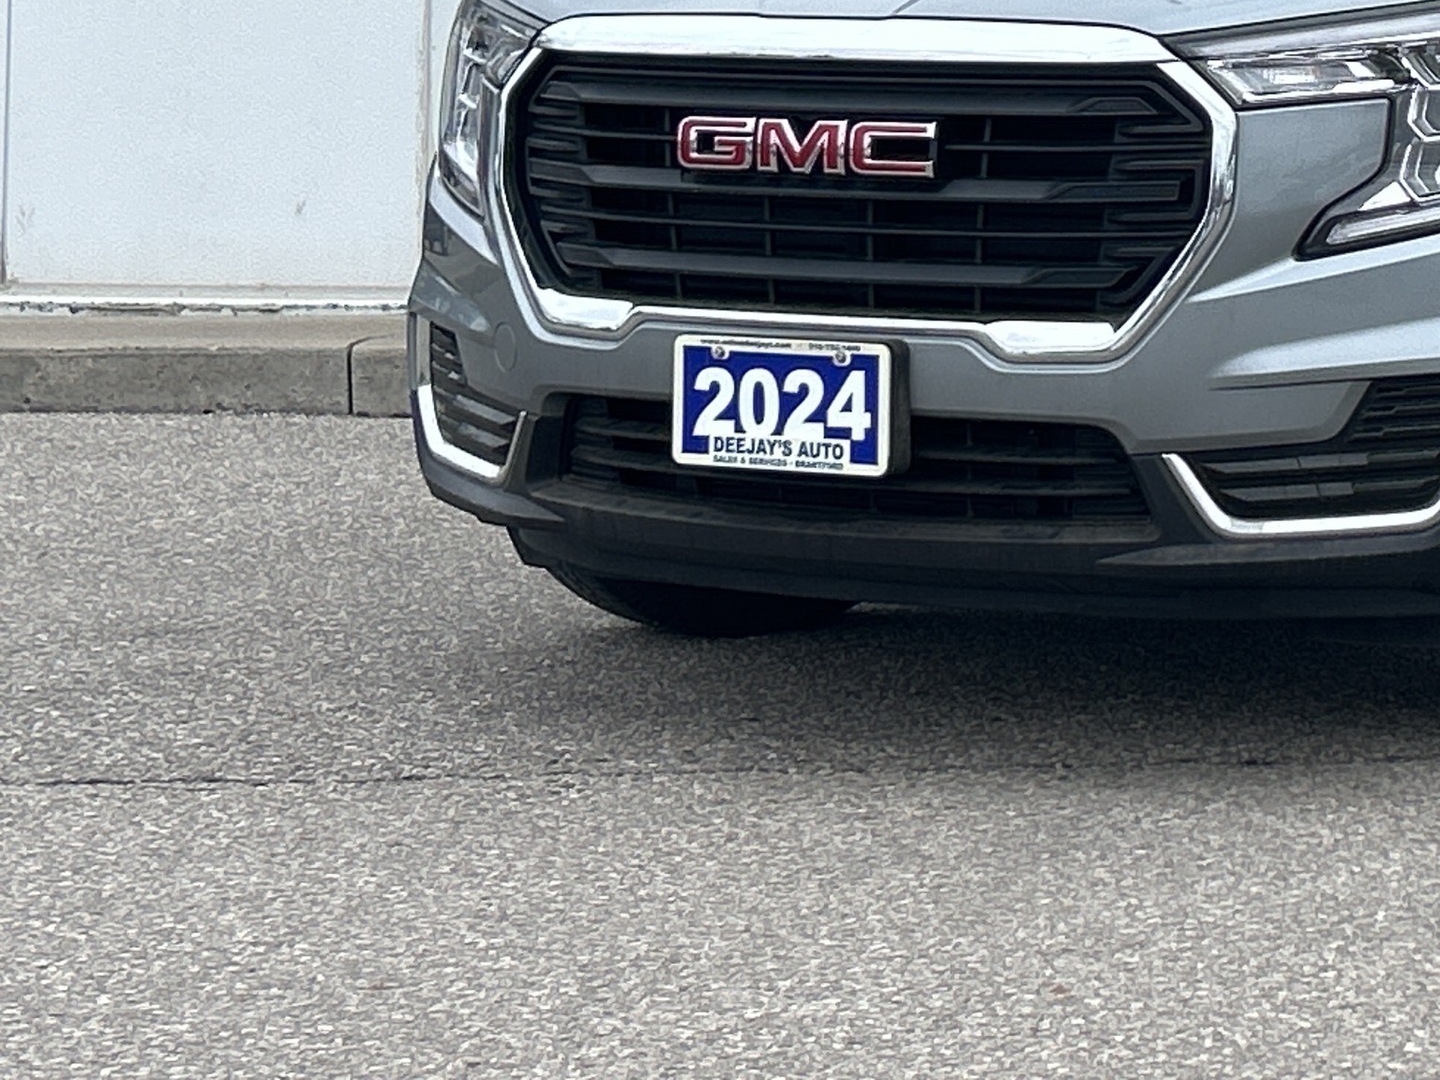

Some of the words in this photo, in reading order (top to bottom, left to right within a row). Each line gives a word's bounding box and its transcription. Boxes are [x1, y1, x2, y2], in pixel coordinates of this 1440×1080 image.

[676, 115, 938, 179] GMC
[692, 366, 872, 441] 2024
[713, 436, 792, 458] DEEJAY'S
[797, 441, 844, 460] AUTO
